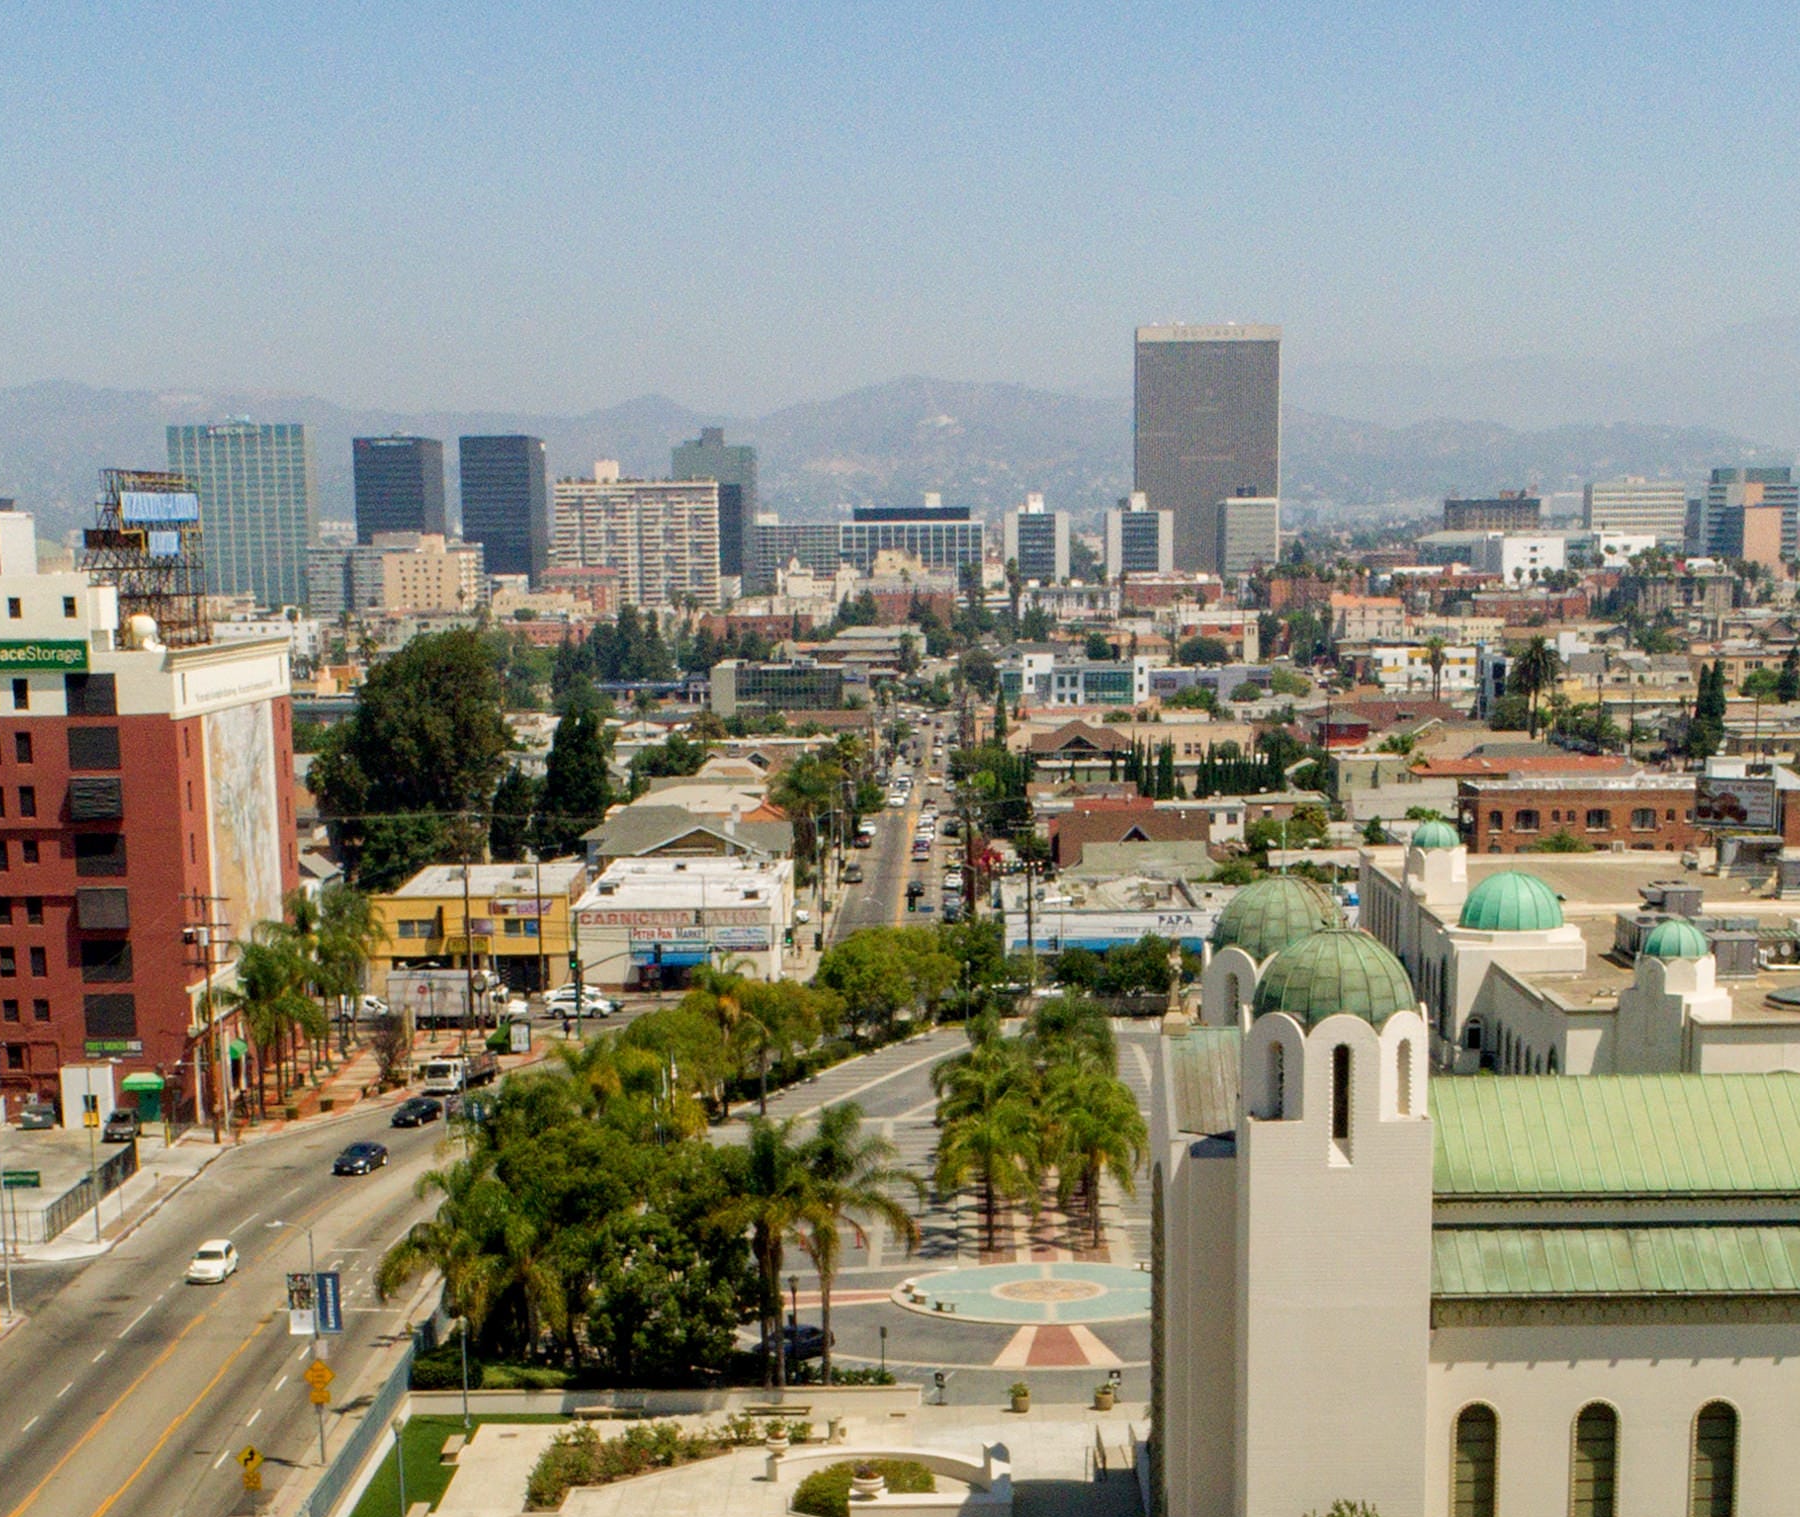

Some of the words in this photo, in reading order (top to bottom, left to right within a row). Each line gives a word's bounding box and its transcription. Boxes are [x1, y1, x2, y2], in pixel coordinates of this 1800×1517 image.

[579, 912, 690, 926] CARNICERIA
[707, 910, 759, 925] ATINA
[1158, 914, 1193, 928] PAPA
[632, 928, 654, 939] PETER
[657, 928, 673, 939] PAN
